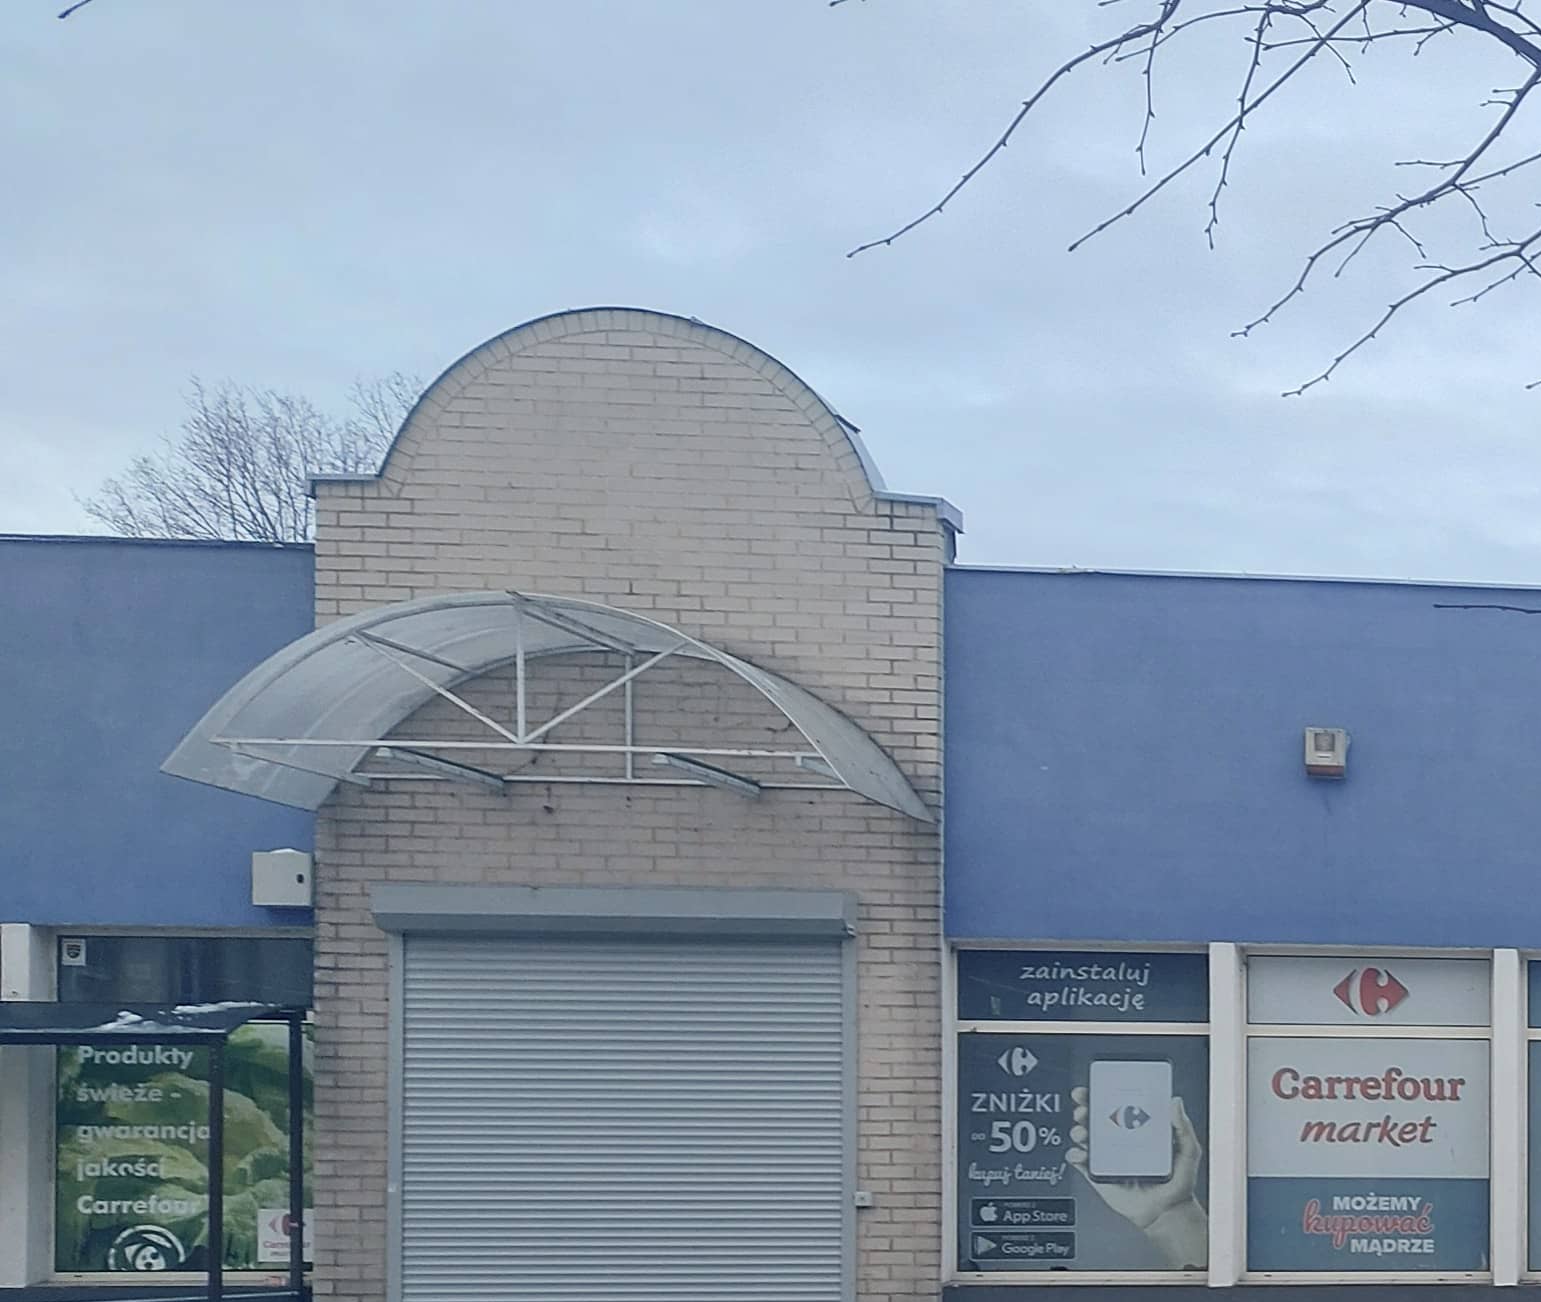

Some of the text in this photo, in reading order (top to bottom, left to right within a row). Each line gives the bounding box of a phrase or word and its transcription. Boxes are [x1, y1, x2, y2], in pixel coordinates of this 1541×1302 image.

[1019, 962, 1150, 986] zainstaluj
[1027, 987, 1145, 1012] aplikację
[77, 1046, 193, 1069] Produkty
[76, 1083, 162, 1102] świeże
[1271, 1067, 1465, 1102] Carrefour
[971, 1088, 1061, 1112] ZNIŻKI
[77, 1121, 211, 1144] gwarancja
[989, 1120, 1061, 1153] 50%
[1299, 1115, 1436, 1148] market
[77, 1195, 201, 1215] Carrefour
[1333, 1193, 1421, 1211] MOŻEMY
[1003, 1210, 1068, 1224] App Store
[1303, 1199, 1434, 1249] kupować
[1001, 1243, 1070, 1256] Google Play
[1350, 1238, 1435, 1256] MĄDRZE
